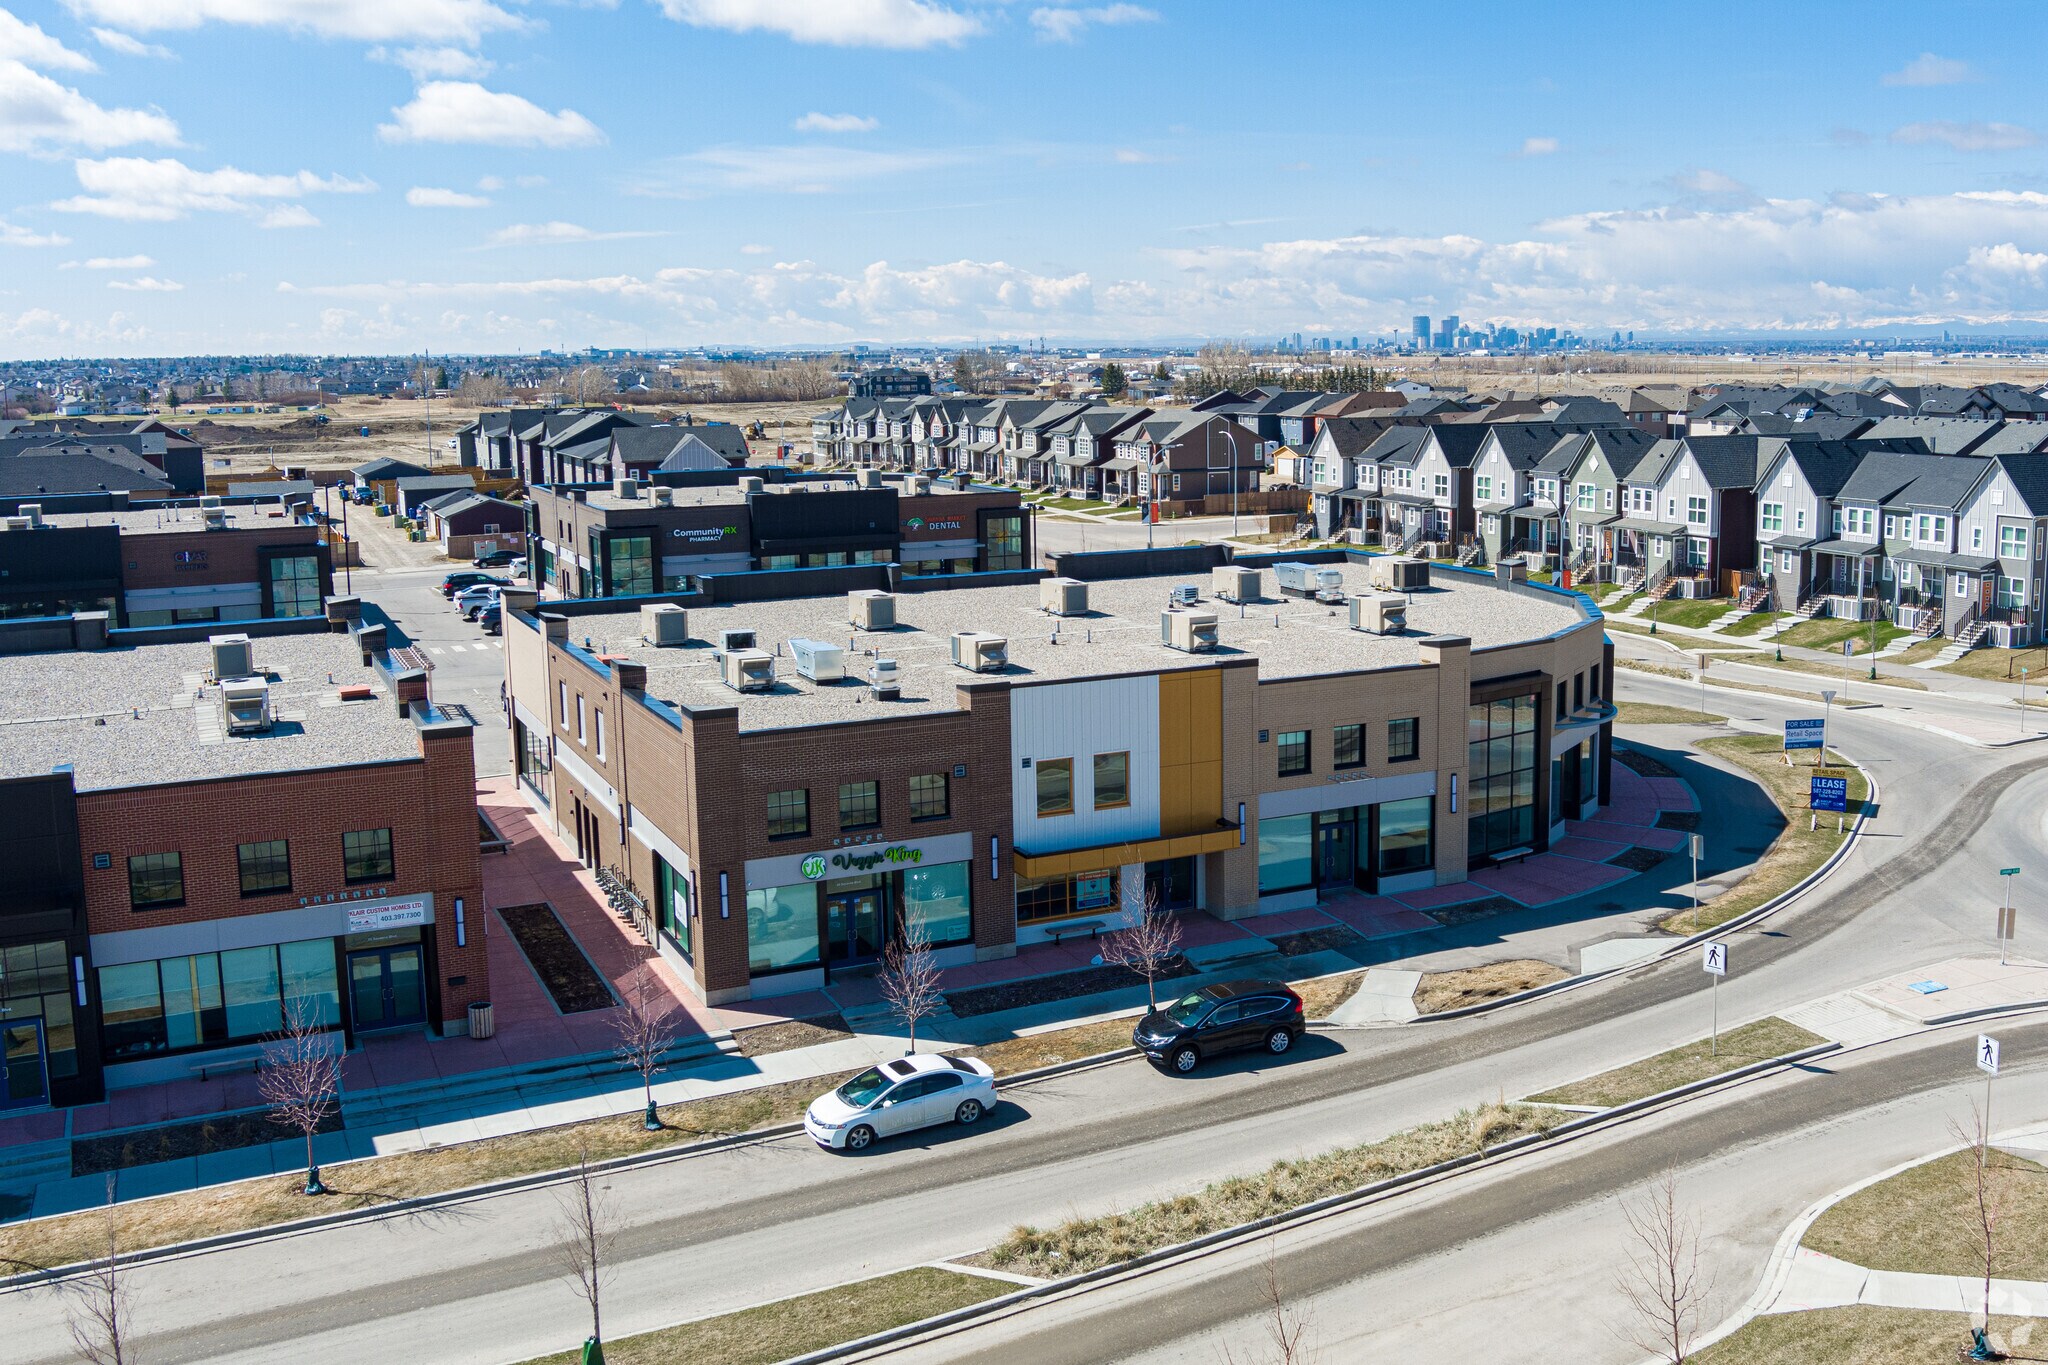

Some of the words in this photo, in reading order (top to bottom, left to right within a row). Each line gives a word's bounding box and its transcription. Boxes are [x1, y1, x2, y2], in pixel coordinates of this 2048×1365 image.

[929, 522, 960, 530] DENTAL
[673, 527, 737, 538] CommunityRX
[689, 535, 721, 543] PHARMACY
[1804, 729, 1823, 738] Space
[1817, 779, 1845, 789] LEASE
[832, 851, 885, 870] Veggie
[884, 845, 922, 863] King
[380, 911, 421, 922] 403.397.7300
